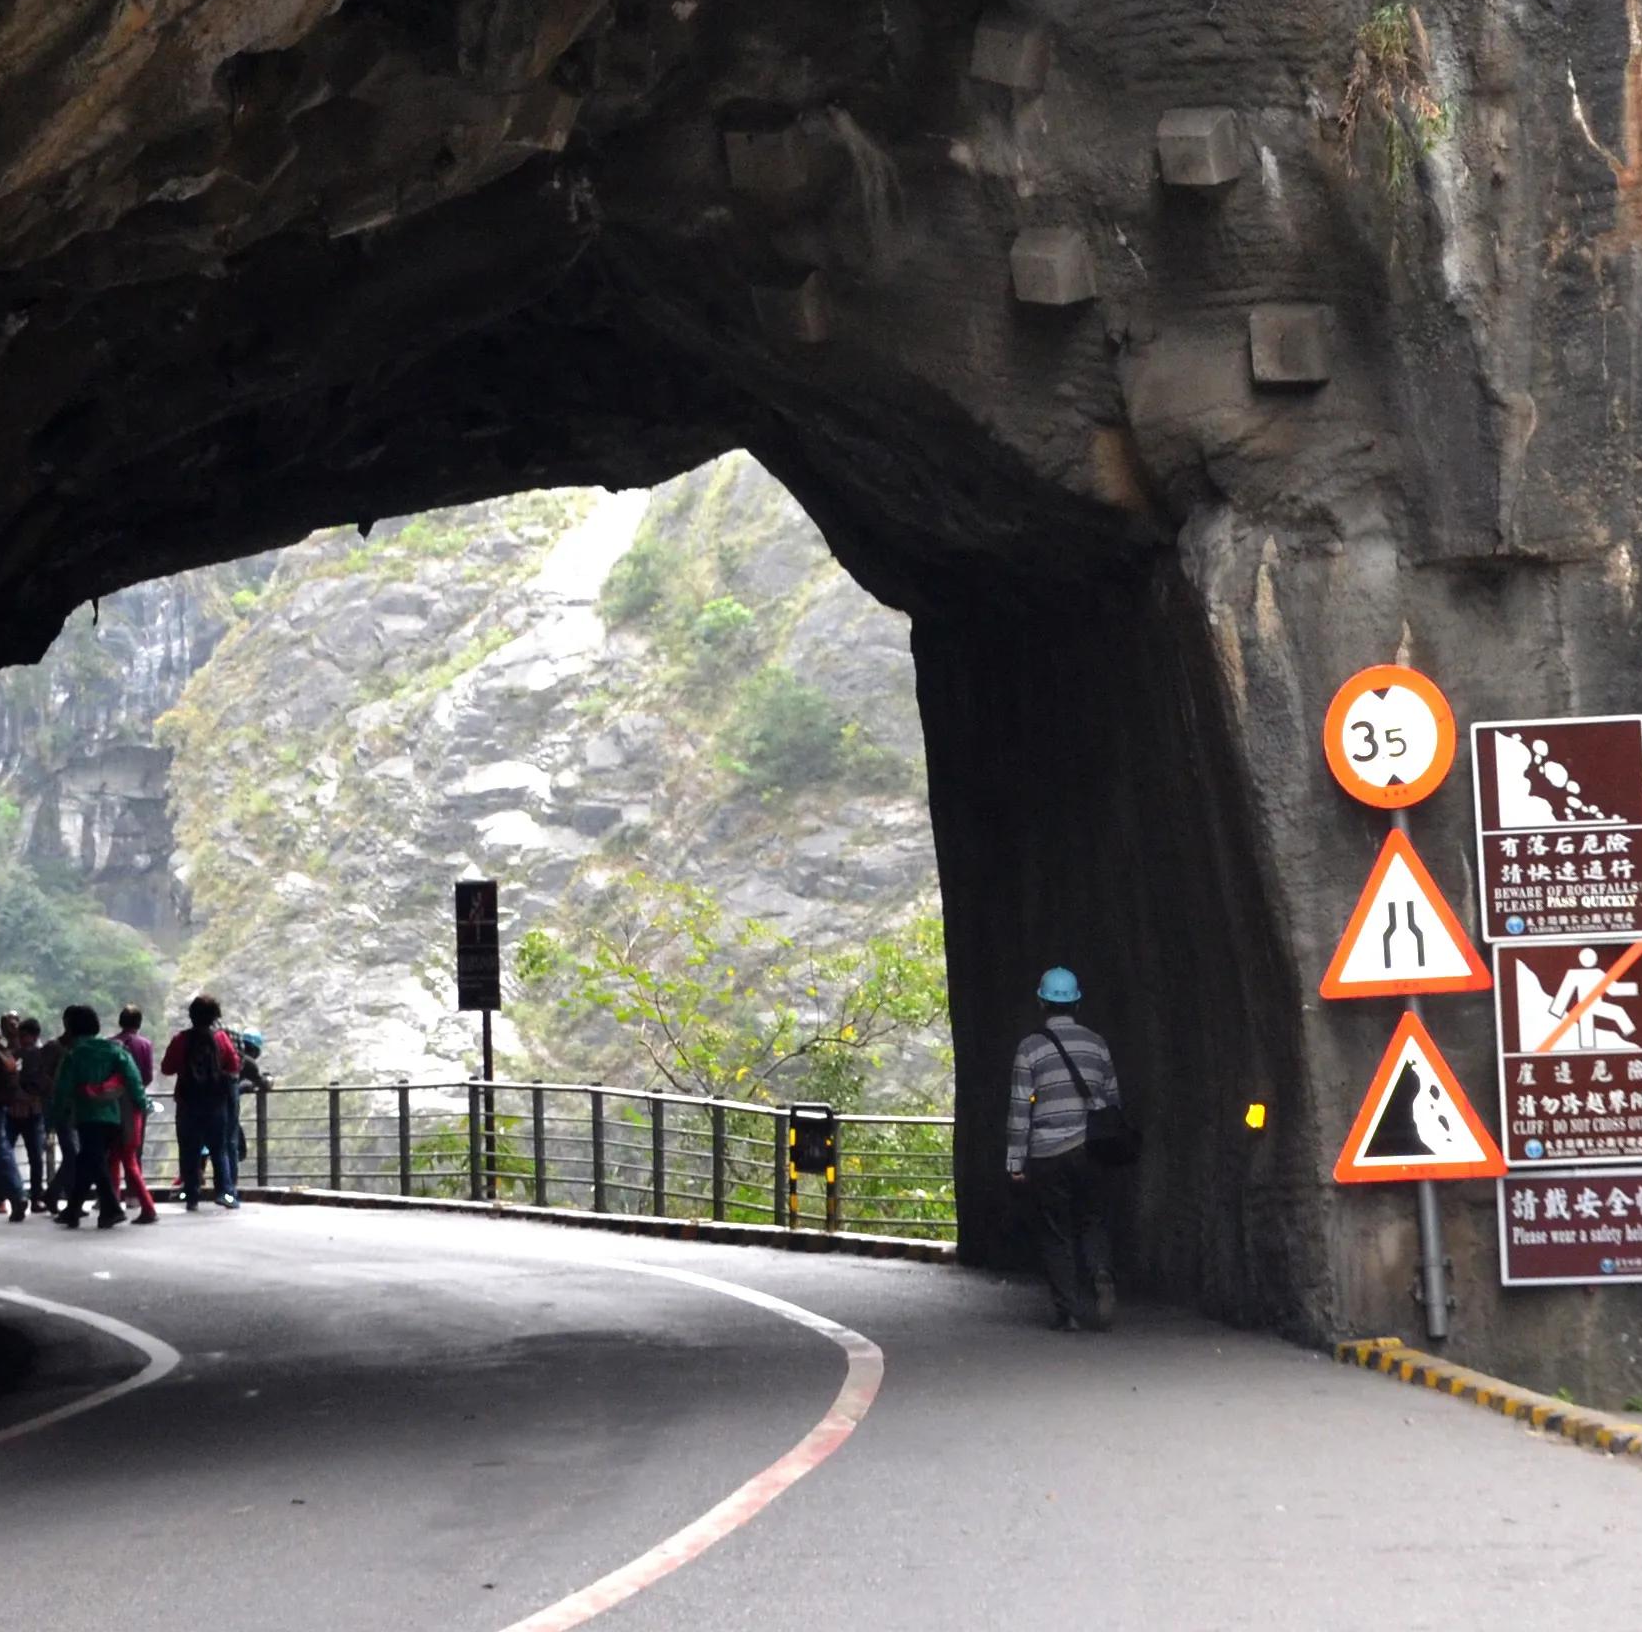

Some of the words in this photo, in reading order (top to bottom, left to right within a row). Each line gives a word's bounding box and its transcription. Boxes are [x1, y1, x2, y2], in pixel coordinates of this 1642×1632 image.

[1499, 833, 1633, 858] 有落石危險
[1501, 859, 1635, 885] 請快速通行
[1494, 885, 1543, 900] BEWARE
[1547, 885, 1563, 897] OF
[1495, 899, 1544, 913] PLEASE
[1547, 895, 1578, 908] PASS
[1553, 1119, 1568, 1134] DO
[1569, 1118, 1590, 1132] NOT
[1592, 1116, 1626, 1132] CROSS
[1512, 1226, 1548, 1245] Please
[1551, 1229, 1577, 1244] wear
[1579, 1229, 1588, 1243] a
[1590, 1224, 1623, 1246] safety
